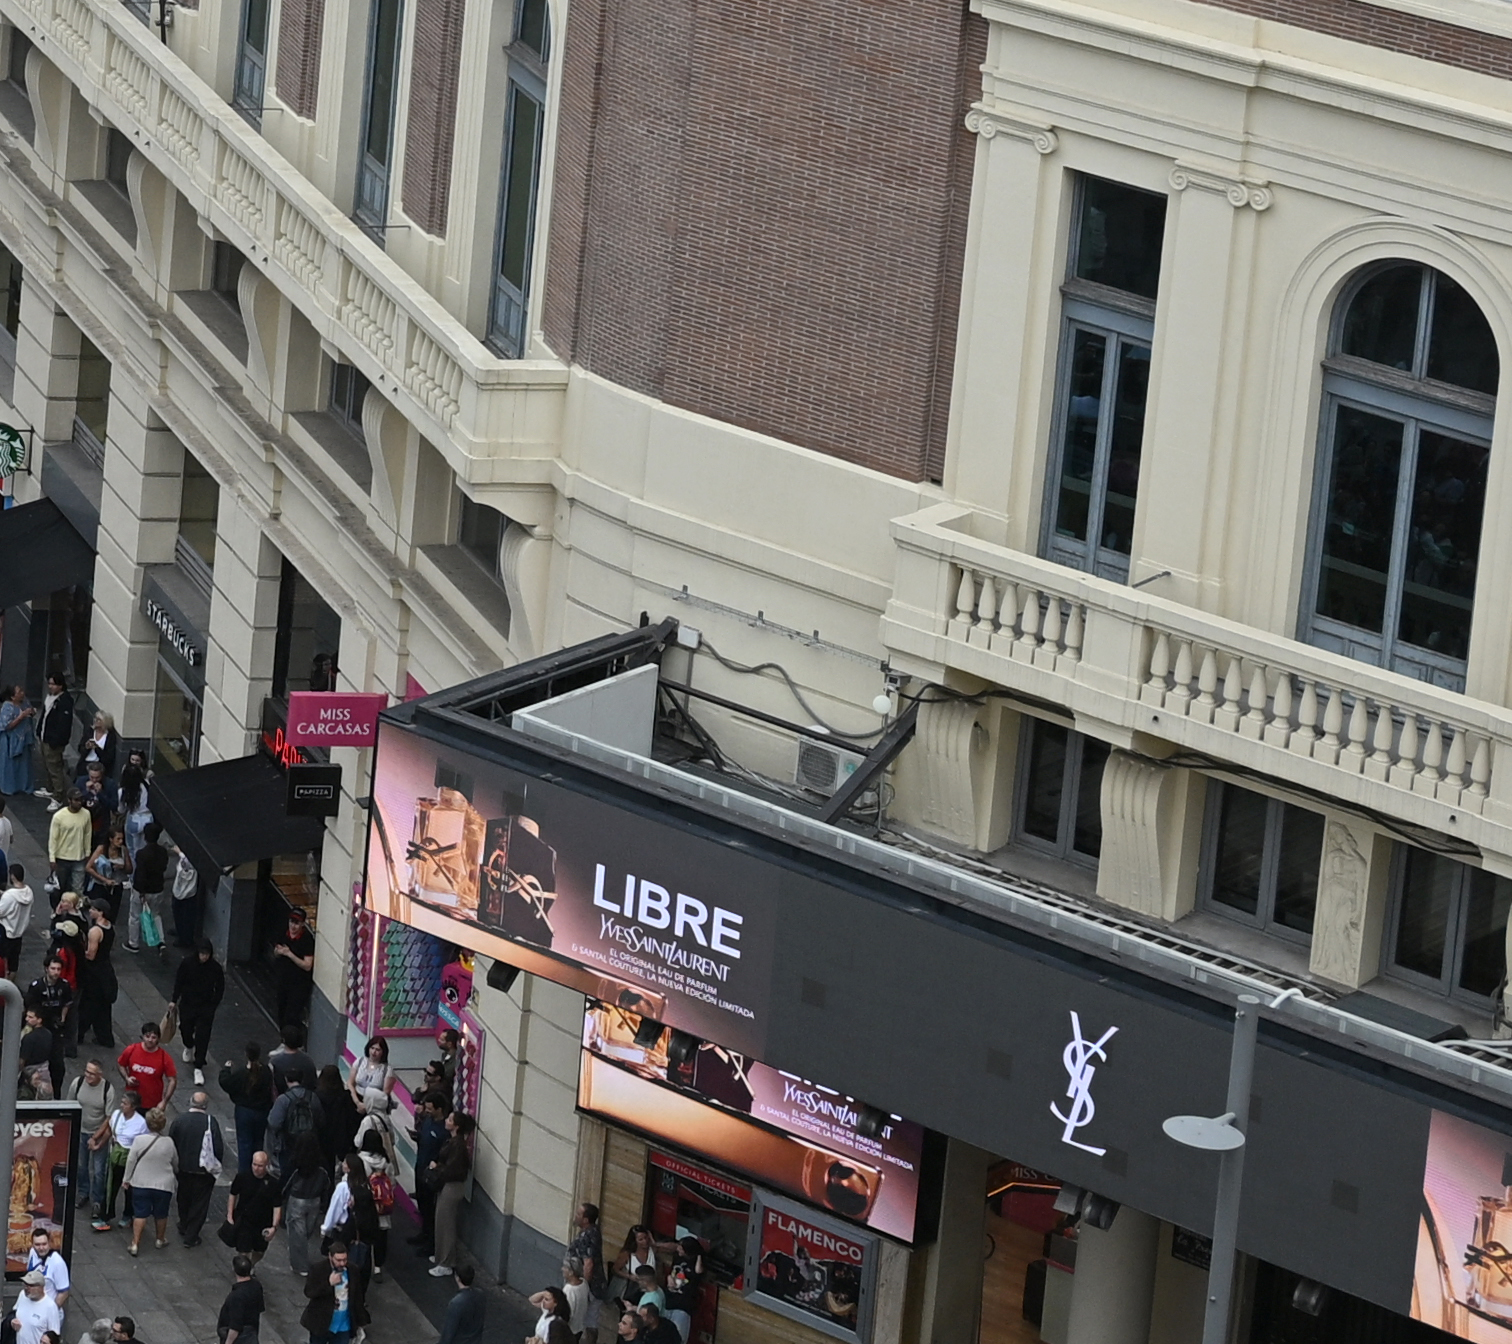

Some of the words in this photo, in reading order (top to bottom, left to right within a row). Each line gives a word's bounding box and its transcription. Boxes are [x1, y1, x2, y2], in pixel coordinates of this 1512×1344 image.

[146, 599, 196, 666] STARBUCKS
[297, 722, 370, 735] CARCASAS
[319, 708, 351, 721] MISS
[593, 863, 744, 959] LIBRE
[579, 945, 608, 964] SANTAL
[646, 971, 657, 983] LA
[658, 976, 684, 993] NUEVA
[718, 1000, 755, 1020] LIMITADA
[610, 947, 619, 957] EL
[619, 950, 657, 973] ORIGINAL
[658, 966, 673, 979] EAU
[674, 971, 685, 983] DE
[686, 976, 718, 996] PARFUM
[665, 1160, 701, 1182] OFFICIAL
[703, 1174, 736, 1194] TICKETS
[768, 1211, 863, 1261] FLAMENCO
